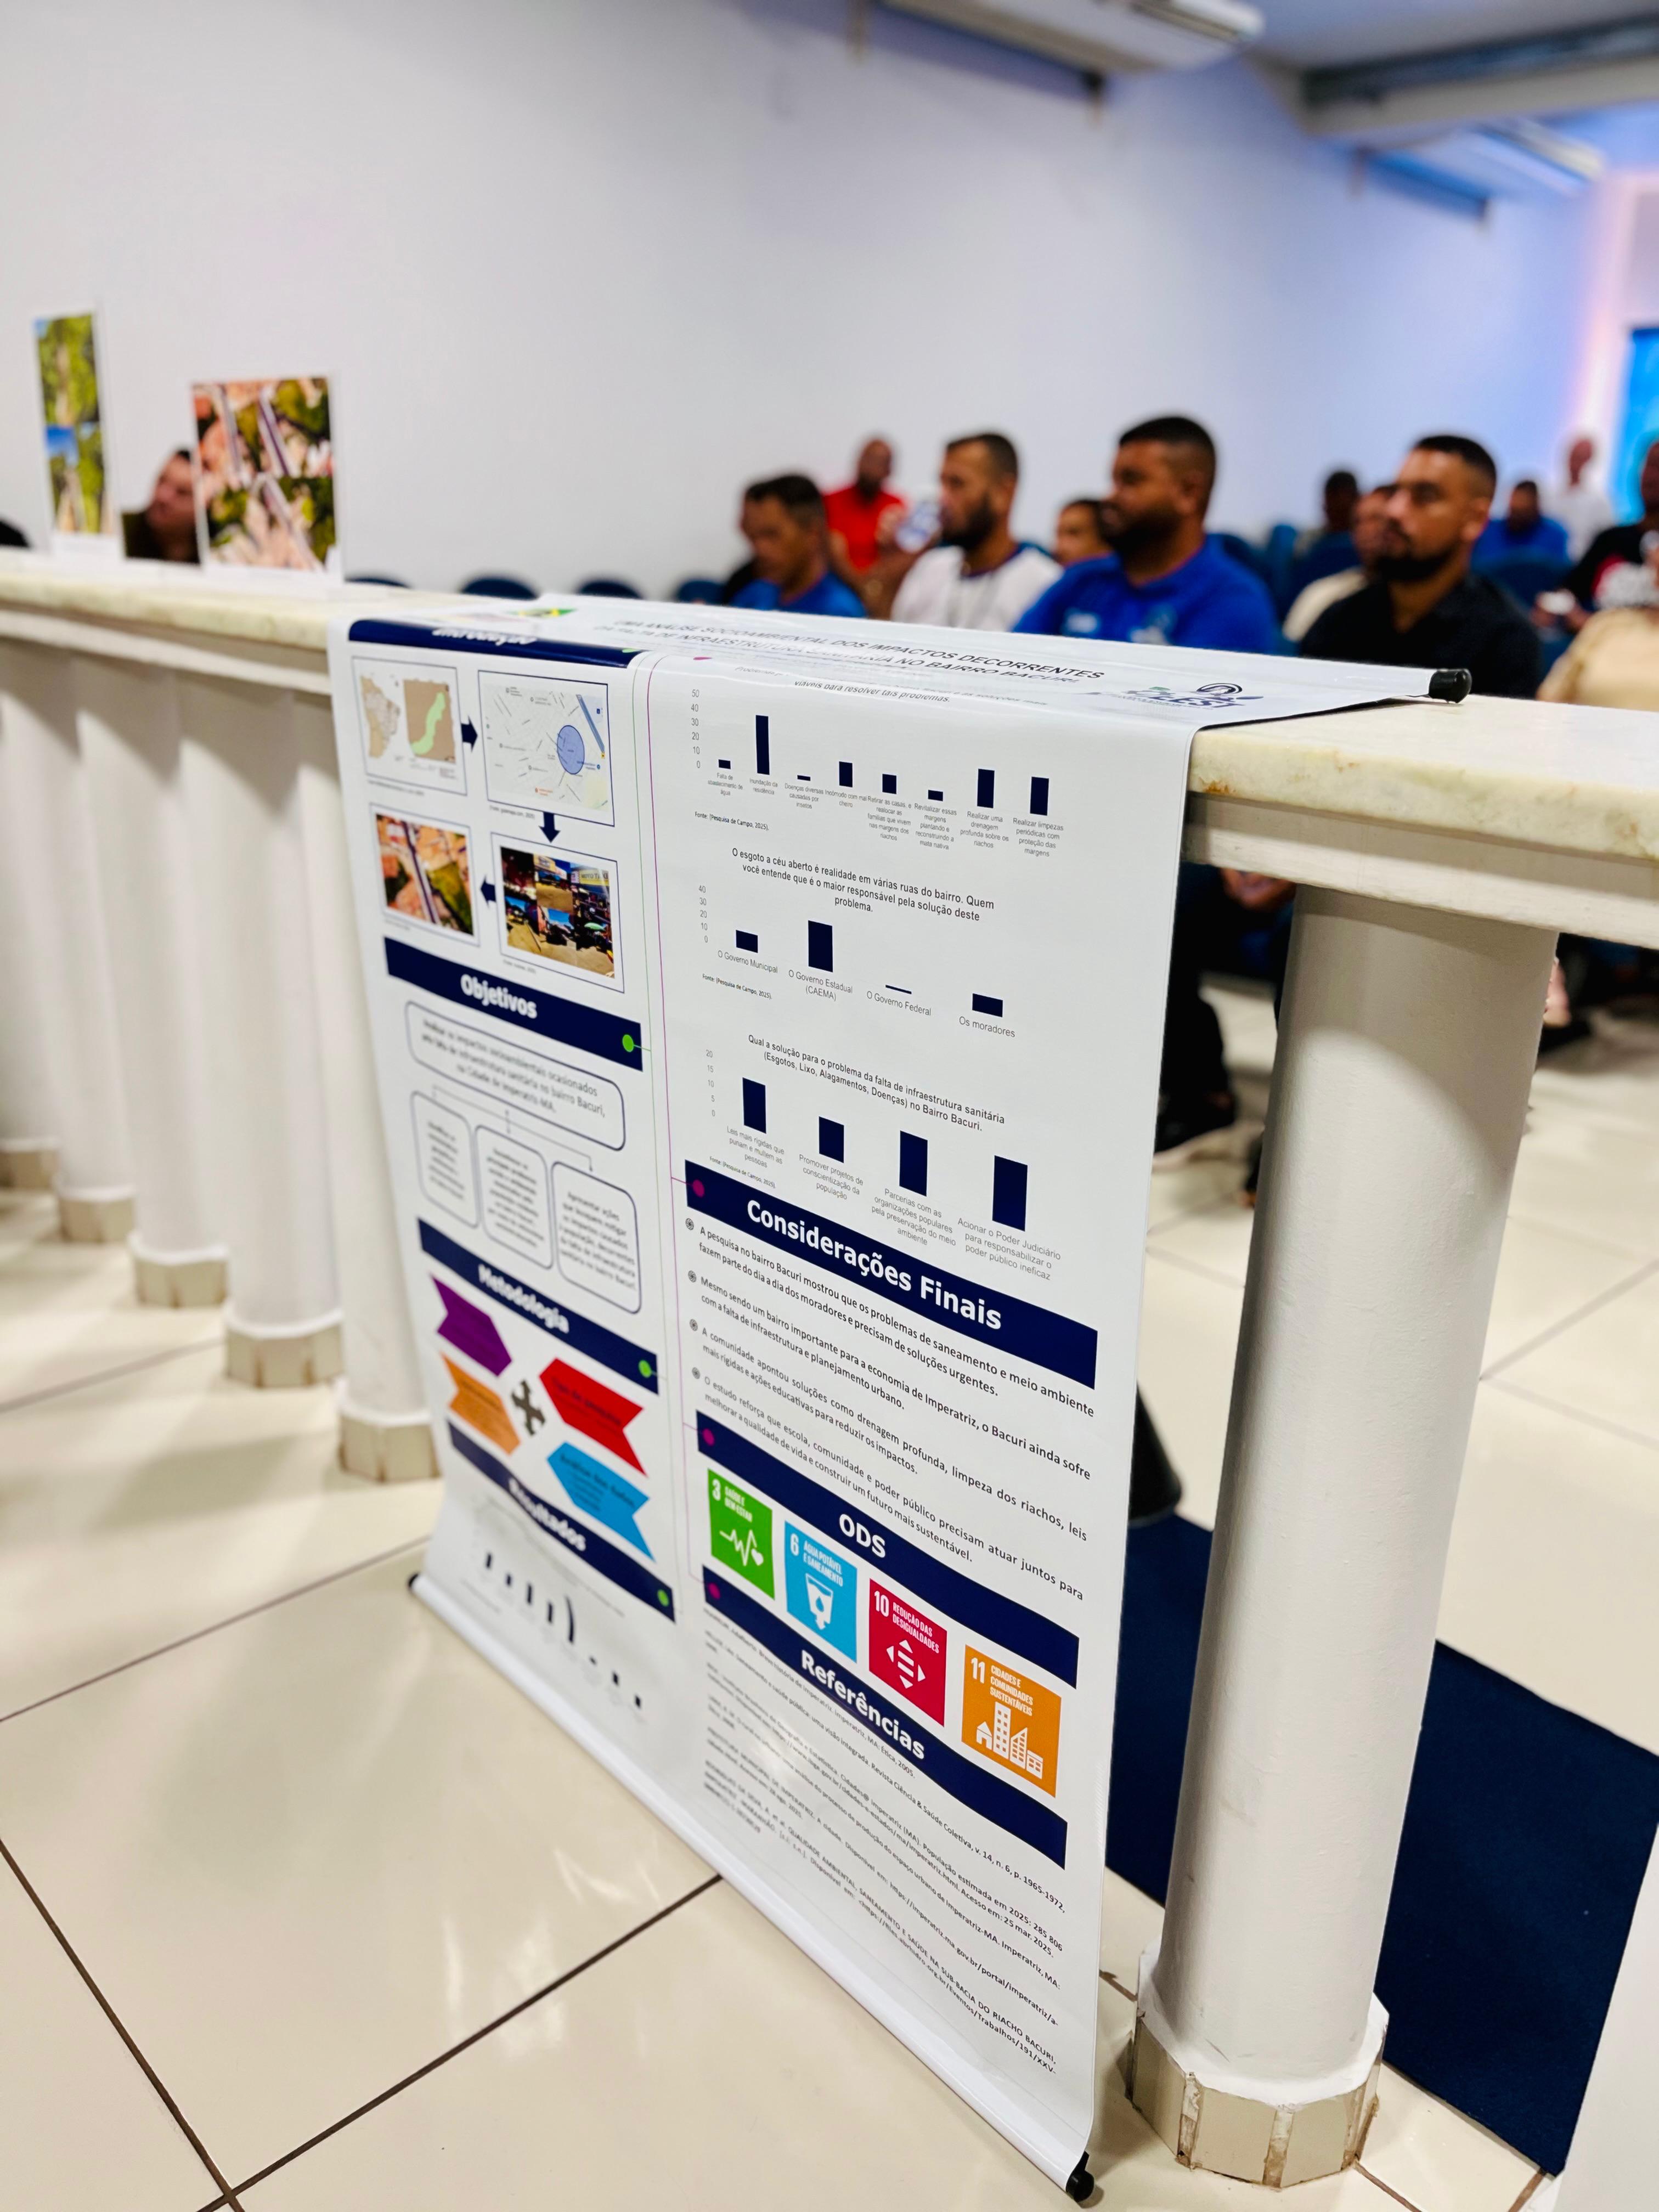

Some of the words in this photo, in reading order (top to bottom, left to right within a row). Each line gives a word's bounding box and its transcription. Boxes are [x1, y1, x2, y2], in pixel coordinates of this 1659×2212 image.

[831, 640, 869, 648] DOS
[868, 644, 961, 660] IMPACTOS
[957, 654, 1105, 679] DECORRENTES
[692, 689, 699, 697] 50
[691, 703, 698, 712] 40
[691, 718, 699, 726] 30
[692, 732, 699, 741] 20
[693, 746, 700, 754] 10
[696, 760, 701, 769] 0
[737, 819, 753, 828] Campo,
[967, 811, 989, 820] Realizar
[970, 821, 998, 831] drenagem
[1013, 817, 1036, 827] Realizar
[1038, 822, 1063, 831] limpezas
[960, 829, 983, 838] profunda
[1016, 829, 1045, 838] periódicas
[1018, 838, 1043, 847] proteção
[1024, 848, 1049, 857] margens
[698, 885, 706, 893] 40
[732, 848, 737, 857] O
[740, 851, 764, 862] esgoto
[772, 857, 786, 867] céu
[788, 860, 812, 872] aberto
[815, 864, 819, 873] é
[821, 867, 856, 881] realidade
[859, 876, 870, 884] em
[873, 877, 897, 890] várias
[900, 884, 918, 894] ruas
[921, 887, 932, 897] do
[935, 889, 963, 903] bairro.
[966, 895, 994, 909] Quem
[699, 897, 707, 906] 30
[742, 865, 759, 874] você
[761, 868, 791, 881] entende
[793, 875, 807, 884] que
[809, 877, 814, 885] é
[823, 881, 845, 891] maior
[847, 887, 895, 903] responsável
[898, 897, 915, 908] pela
[917, 901, 952, 916] solução
[955, 908, 979, 921] deste
[834, 897, 872, 912] problema.
[700, 910, 707, 918] 20
[701, 922, 708, 930] 10
[718, 950, 723, 958] O
[724, 952, 748, 966] Governo
[750, 959, 777, 973] Municipal
[788, 969, 794, 978] O
[795, 971, 823, 985] Governo
[825, 978, 852, 993] Estadual
[805, 985, 836, 1001] (CAEMA)
[460, 974, 538, 1019] Objetivos
[866, 990, 872, 1000] O
[874, 993, 902, 1008] Governo
[905, 1001, 931, 1015] Federal
[959, 1016, 969, 1026] Os
[972, 1022, 1015, 1037] moradores
[748, 1035, 764, 1046] Qual
[772, 1044, 800, 1058] solução
[802, 1053, 818, 1064] para
[827, 1061, 861, 1078] problema
[864, 1072, 872, 1082] da
[875, 1075, 891, 1088] falta
[894, 1082, 903, 1092] de
[906, 1086, 962, 1111] infraestrutura
[964, 1107, 1004, 1124] sanitária
[764, 1052, 797, 1070] (Esgotos,
[799, 1063, 817, 1076] Lixo,
[819, 1070, 868, 1094] Alagamentos,
[872, 1087, 907, 1108] Doenças)
[910, 1102, 920, 1111] no
[923, 1104, 948, 1120] Bairro
[951, 1113, 981, 1131] Bacuri.
[957, 1217, 986, 1234] Acionar
[996, 1231, 1020, 1245] Poder
[1022, 1240, 1060, 1260] Judiciário
[965, 1233, 981, 1244] para
[984, 1240, 1044, 1266] responsabilizar
[747, 1199, 912, 1292] Considerações
[921, 1275, 1002, 1330] Finais
[966, 1245, 987, 1257] poder
[989, 1254, 1017, 1268] público
[1020, 1264, 1050, 1280] ineficaz
[841, 1295, 857, 1308] que
[859, 1304, 868, 1314] os
[871, 1309, 917, 1339] problemas
[919, 1333, 930, 1346] de
[933, 1341, 997, 1374] saneamento
[1000, 1370, 1006, 1379] e
[1009, 1373, 1037, 1391] meio
[1040, 1386, 1093, 1417] ambiente
[926, 1394, 979, 1430] Imperatriz,
[982, 1424, 989, 1432] o
[992, 1425, 1026, 1449] Bacuri
[1029, 1444, 1060, 1464] ainda
[1063, 1459, 1090, 1480] sofre
[712, 1479, 721, 1501] 3
[903, 1441, 947, 1474] profunda,
[952, 1466, 991, 1494] limpeza
[997, 1489, 1016, 1505] dos
[1021, 1501, 1064, 1530] riachos,
[1069, 1522, 1086, 1541] leis
[791, 1533, 799, 1556] 6
[839, 1513, 885, 1559] ODS
[875, 1479, 900, 1499] poder
[903, 1497, 935, 1522] público
[939, 1519, 984, 1548] precisam
[988, 1545, 1017, 1564] atuar
[1020, 1558, 1055, 1584] juntos
[1059, 1581, 1082, 1600] para
[874, 1590, 889, 1617] 10
[893, 1601, 919, 1628] REDUÇÃO
[920, 1620, 933, 1638] DAS
[893, 1613, 939, 1654] DESIGUALDADES
[971, 1657, 985, 1684] 11
[991, 1664, 1016, 1684] CIDADES
[1017, 1677, 1021, 1688] E
[990, 1676, 1034, 1706] COMUNIDADES
[990, 1687, 1032, 1717] SUSTENTÁVEIS
[802, 1650, 924, 1760] Referências
[871, 1763, 893, 1785] Revista
[894, 1781, 916, 1804] Ciência
[923, 1805, 943, 1826] Saúde
[944, 1824, 973, 1851] Coletiva,
[983, 1851, 994, 1864] 14,
[996, 1860, 1003, 1869] n.
[1005, 1865, 1012, 1875] 6,
[1014, 1871, 1021, 1880] p.
[1023, 1876, 1065, 1913] 1965-1972,
[958, 1875, 991, 1901] estimada
[994, 1899, 1006, 1911] em
[1009, 1907, 1031, 1926] 2025:
[1033, 1923, 1047, 1941] 285
[1049, 1936, 1062, 1951] 806
[993, 2011, 1023, 2036] RIACHO
[1025, 2035, 1056, 2064] BACURI,
